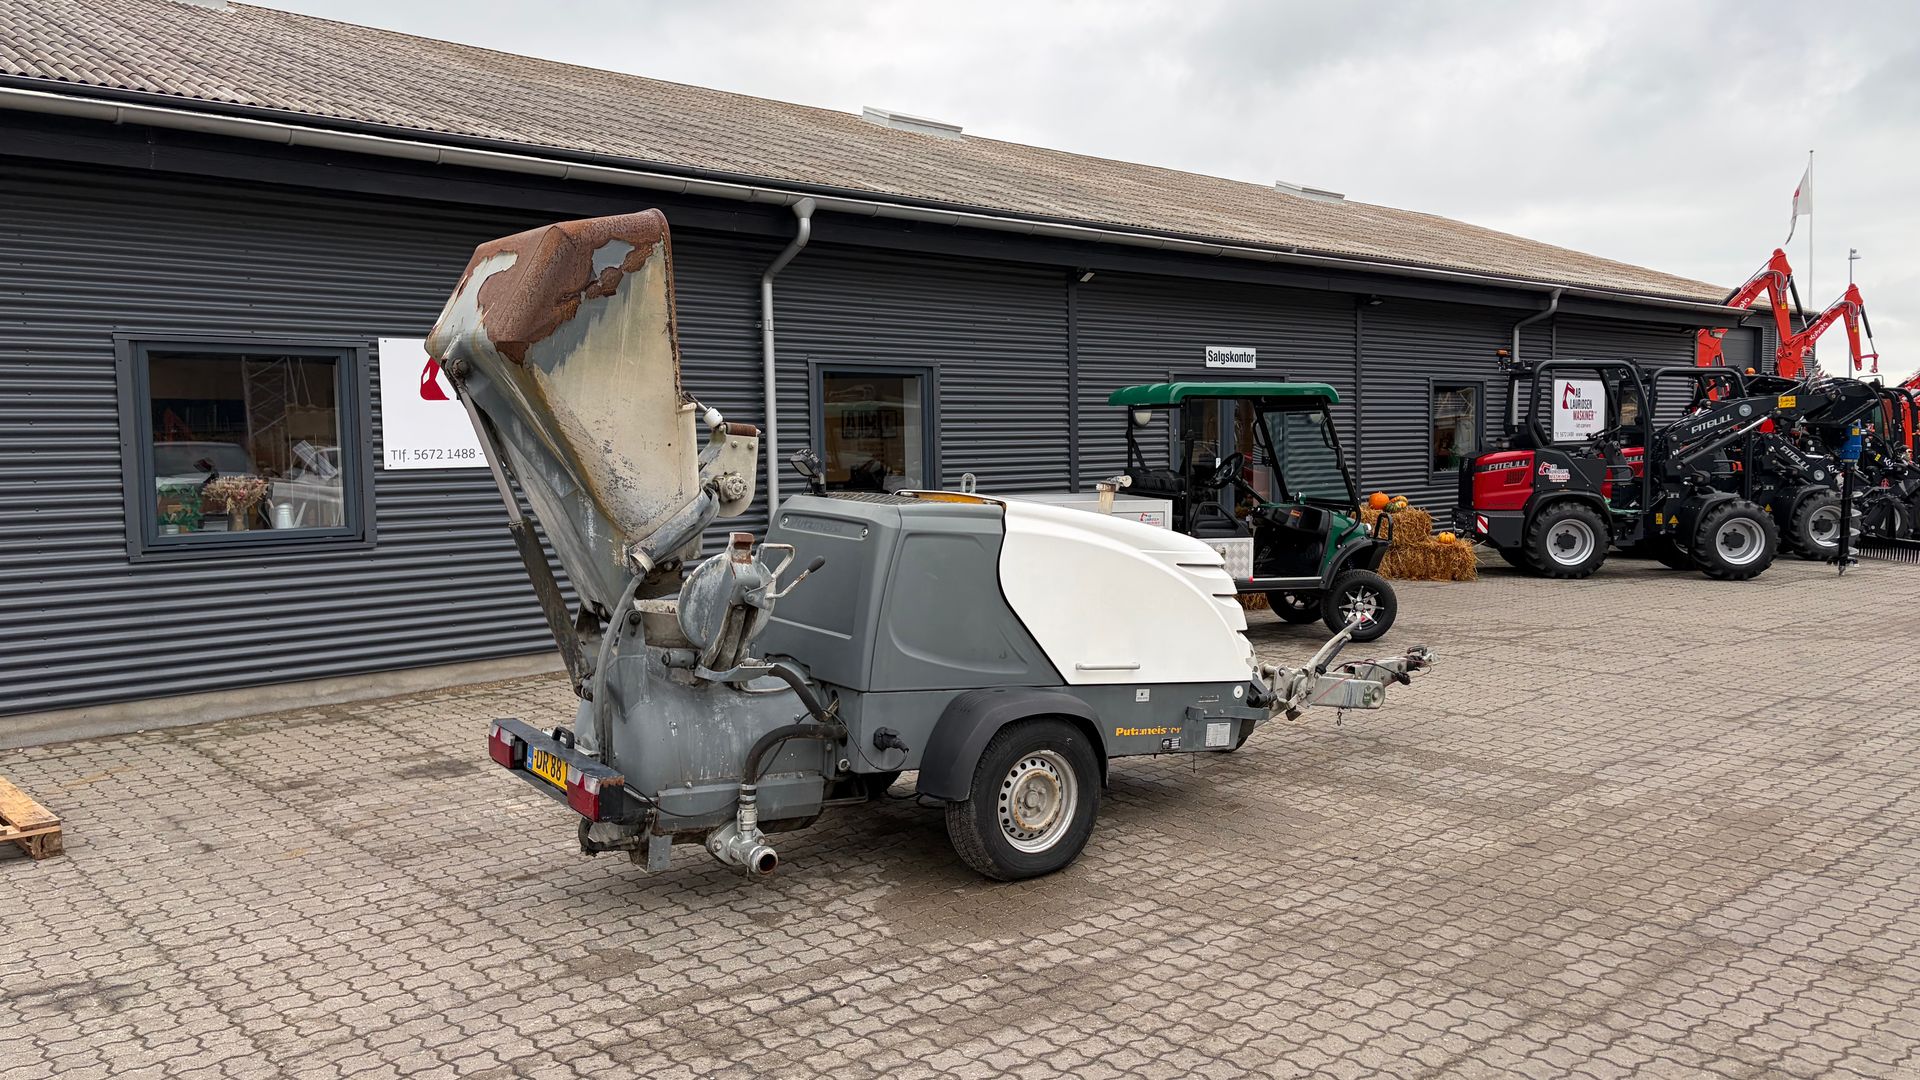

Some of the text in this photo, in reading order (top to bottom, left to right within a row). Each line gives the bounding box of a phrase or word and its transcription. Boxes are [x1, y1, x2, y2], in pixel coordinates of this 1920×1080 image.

[1207, 349, 1255, 365] Salgskontor
[1691, 413, 1734, 434] PITBULL
[390, 449, 410, 462] Tlf.
[414, 449, 443, 460] 5672
[447, 448, 476, 459] 1488
[1488, 459, 1527, 471] PITBULL
[536, 749, 549, 774] DR
[550, 755, 562, 782] 88
